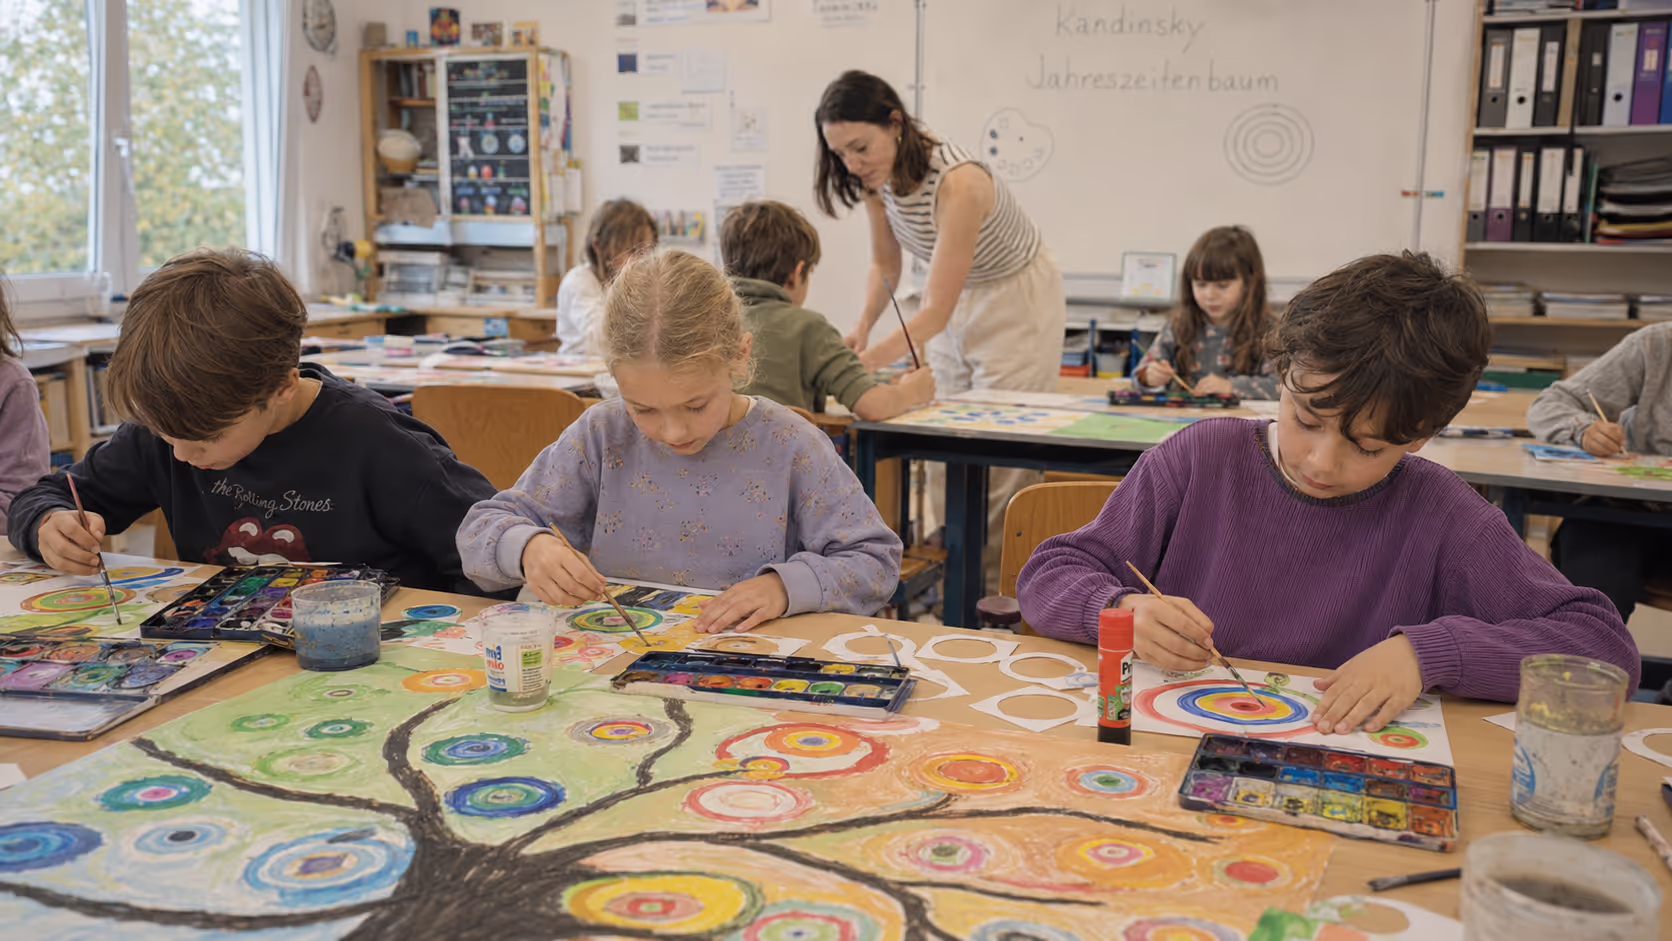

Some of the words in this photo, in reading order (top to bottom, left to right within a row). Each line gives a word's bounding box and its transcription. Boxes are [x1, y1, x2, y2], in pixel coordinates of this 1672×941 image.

[1056, 2, 1206, 54] Kandinsky
[211, 477, 233, 496] the
[233, 484, 278, 519] Rolling
